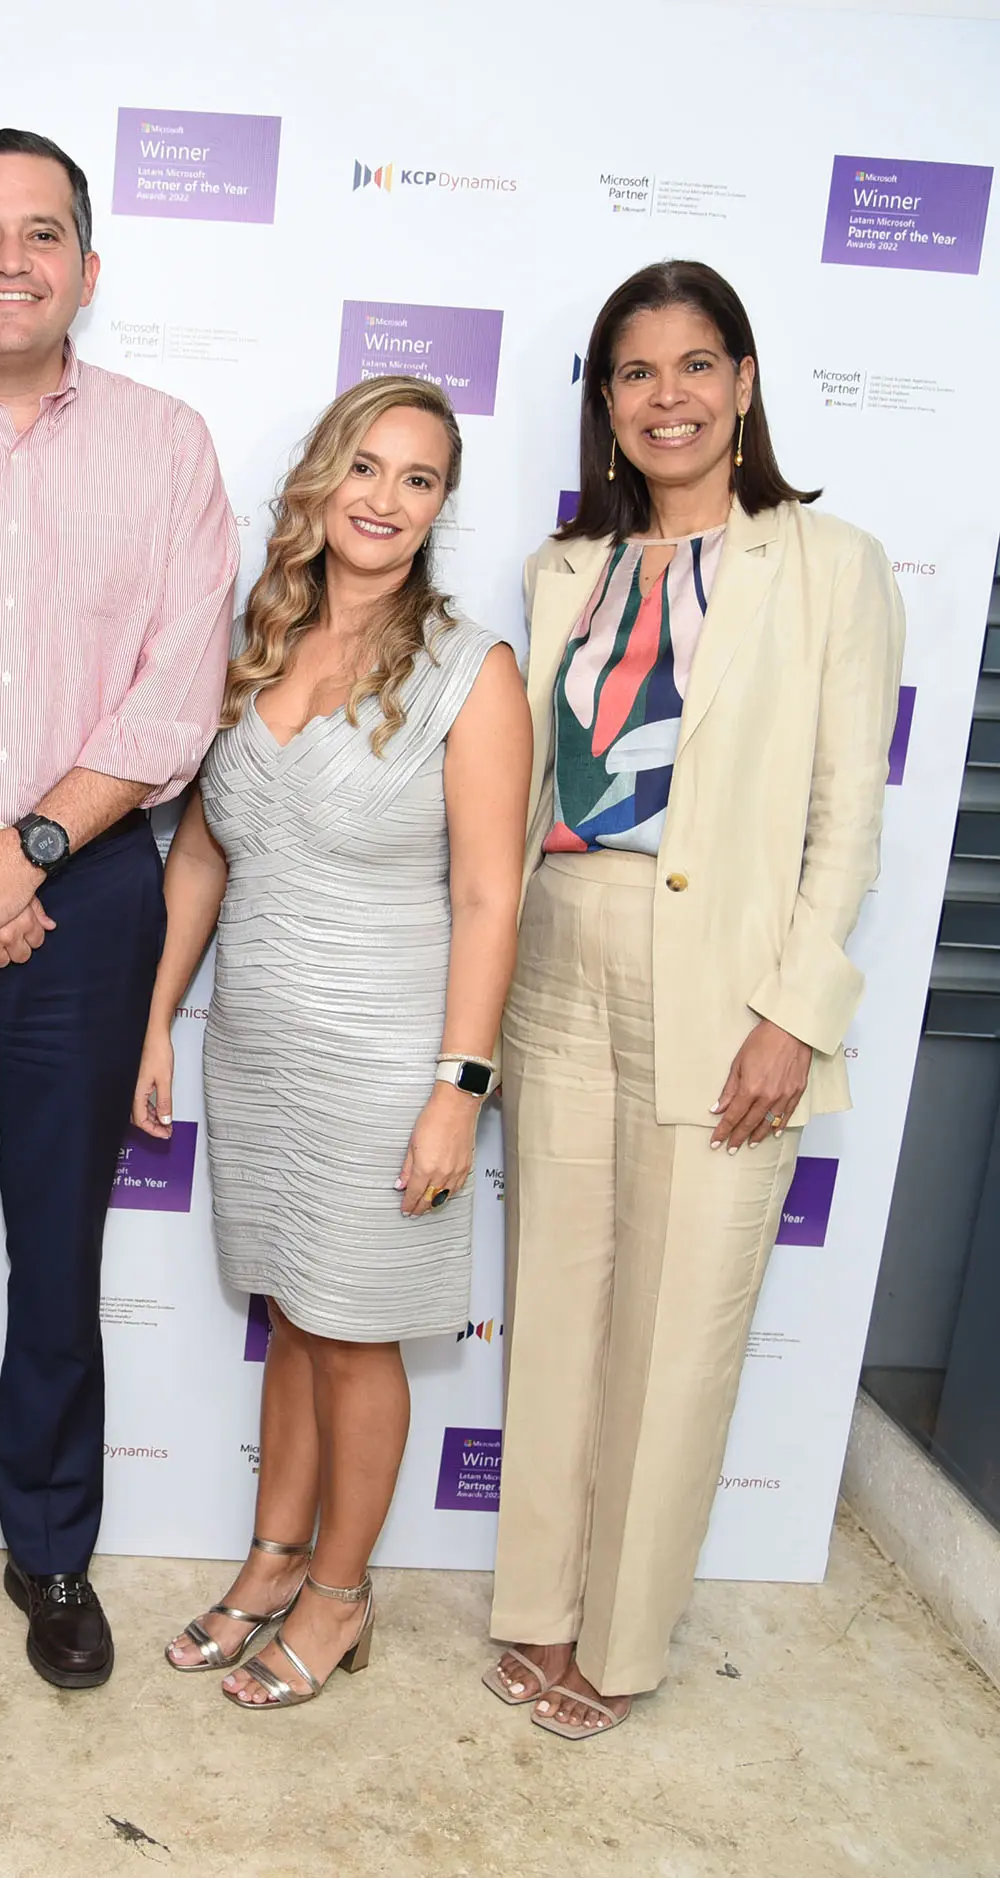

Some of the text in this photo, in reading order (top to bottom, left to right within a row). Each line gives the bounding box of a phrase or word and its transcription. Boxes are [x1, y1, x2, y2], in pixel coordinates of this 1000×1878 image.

[140, 140, 210, 161] Winner
[166, 168, 205, 178] Microsoft
[865, 173, 897, 183] Microsoft
[138, 178, 248, 195] Partner of the Year
[401, 170, 517, 192] KCP Dynamics
[600, 174, 649, 187] Microsoft
[609, 187, 648, 200] Partner
[853, 188, 922, 210] Winner
[850, 216, 915, 228] Latam Microsoft
[848, 226, 957, 245] Partner of the Year
[846, 240, 898, 251] Awards 2022
[110, 321, 160, 334] Microsoft
[375, 317, 408, 328] Microsoft
[120, 333, 158, 346] Partner
[364, 332, 432, 354] Winner
[445, 374, 470, 387] Year
[813, 368, 861, 382] Microsoft
[821, 382, 860, 395] Partner
[892, 560, 936, 575] amics
[175, 1006, 208, 1019] mics
[124, 1176, 142, 1186] the
[145, 1177, 167, 1188] Year
[782, 1213, 805, 1224] Year
[458, 1480, 495, 1490] Partner
